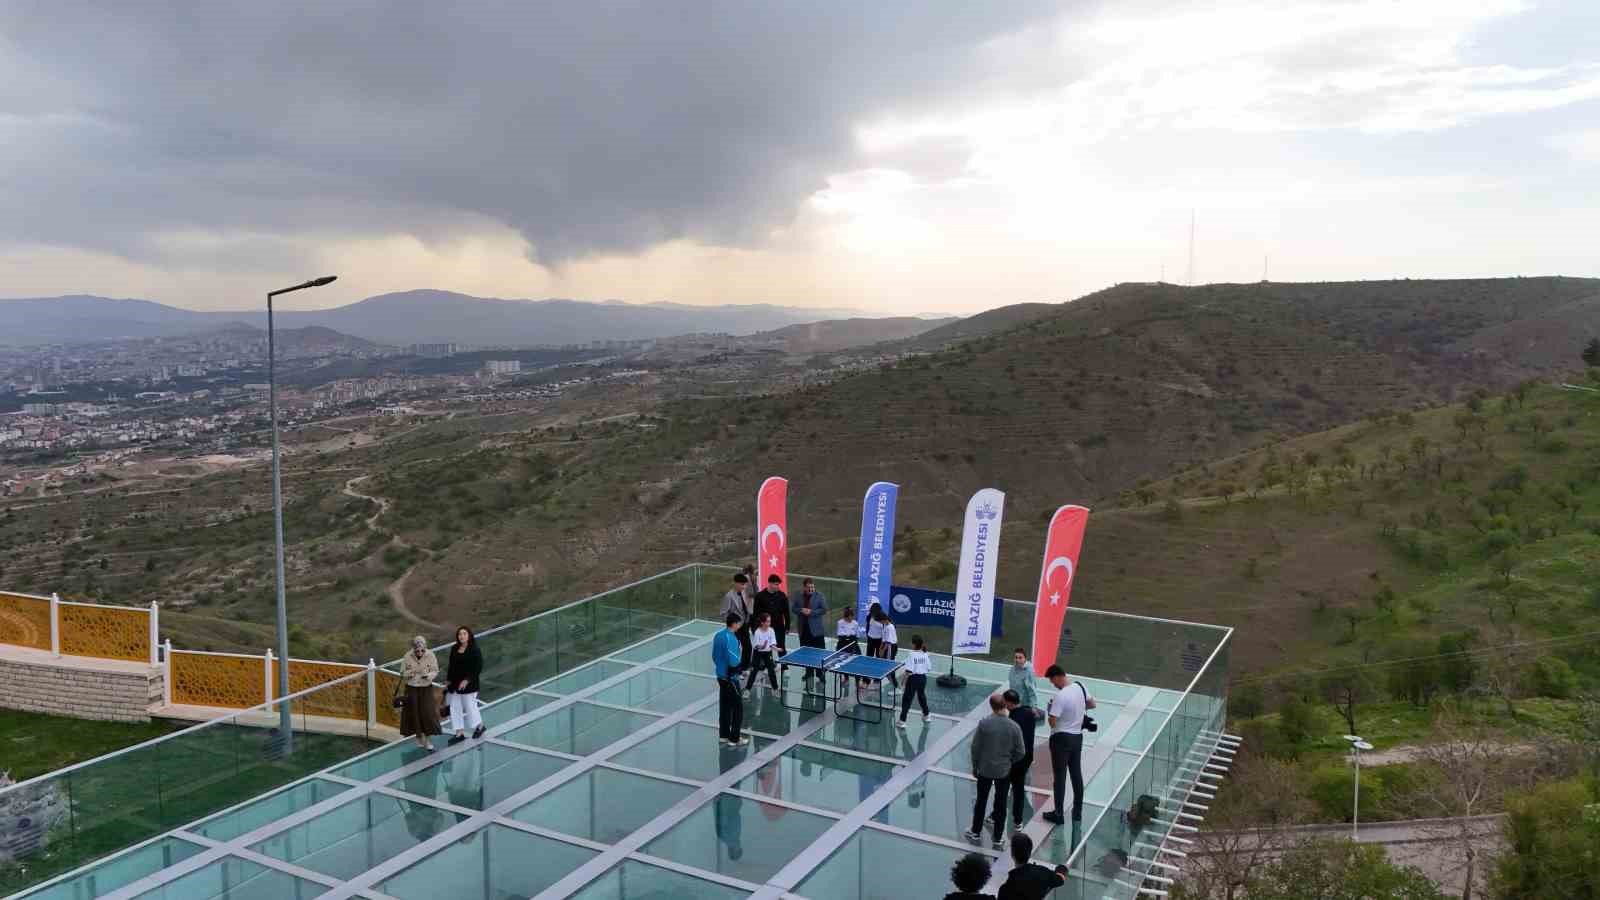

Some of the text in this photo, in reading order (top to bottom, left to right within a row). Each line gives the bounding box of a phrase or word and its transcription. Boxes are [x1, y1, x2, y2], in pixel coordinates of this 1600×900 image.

[869, 492, 887, 592] ELAZIĞ BELEDİYESİ
[968, 523, 988, 636] ELAZIĞ BELEDİYESİ
